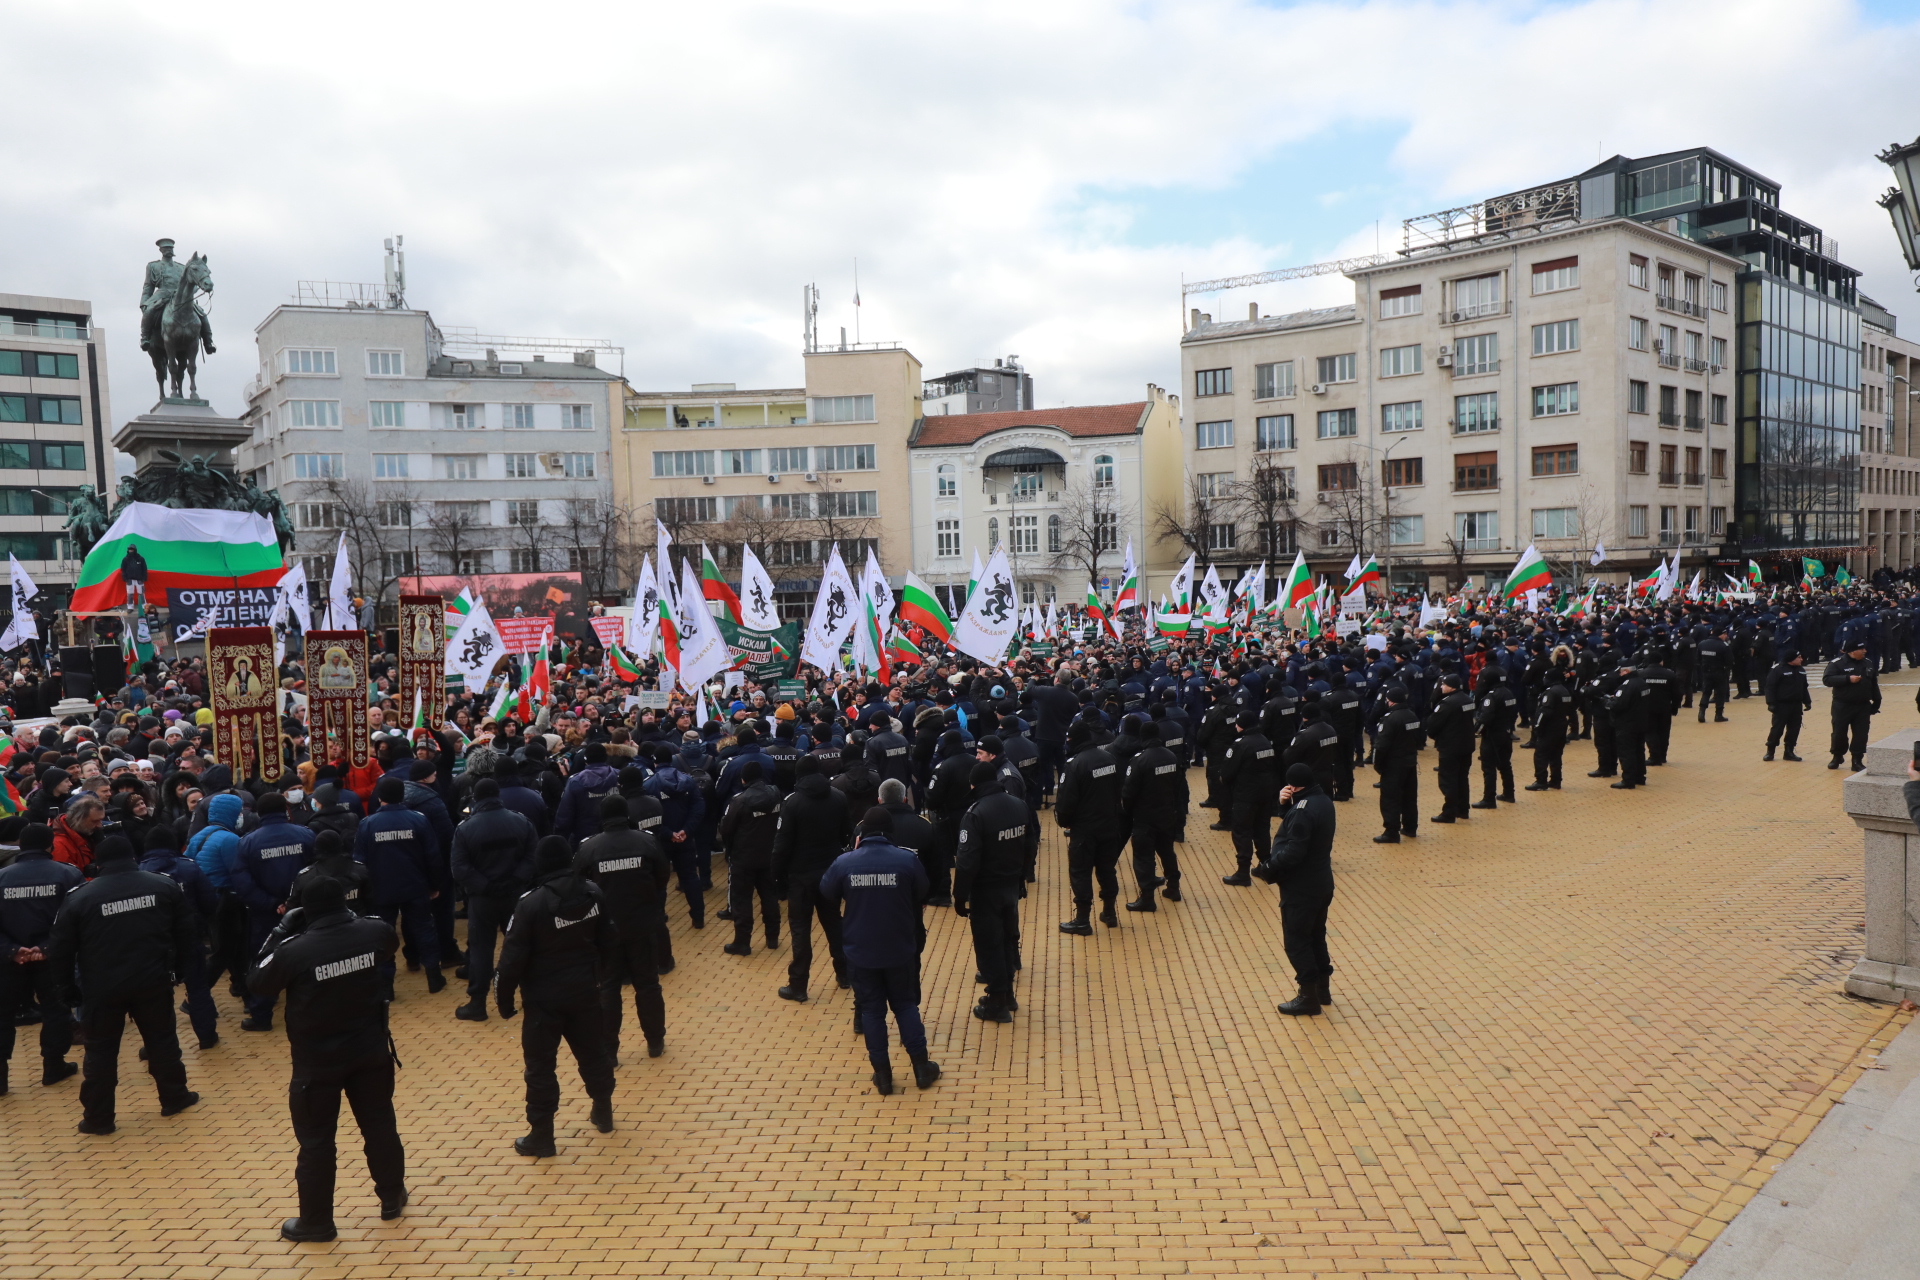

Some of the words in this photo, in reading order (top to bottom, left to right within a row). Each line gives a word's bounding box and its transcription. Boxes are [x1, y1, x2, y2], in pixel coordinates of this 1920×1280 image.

[179, 589, 269, 606] ОТМЯНА
[195, 606, 281, 622] ЗЕЛЕНИ
[738, 636, 767, 650] ИСКАМ
[818, 751, 841, 761] POLICE
[374, 830, 397, 842] SECURITY
[397, 829, 414, 840] POLICE
[998, 824, 1026, 841] POLICE
[260, 846, 286, 860] SECURITY
[285, 843, 303, 857] POLICE
[598, 856, 642, 873] GENDARMERY
[850, 874, 877, 887] SECURITY
[877, 873, 897, 886] POLICE
[3, 886, 35, 900] SECURITY
[35, 884, 57, 898] POLICE
[101, 894, 156, 916] GENDARMERY
[315, 951, 375, 982] GENDARMERY
